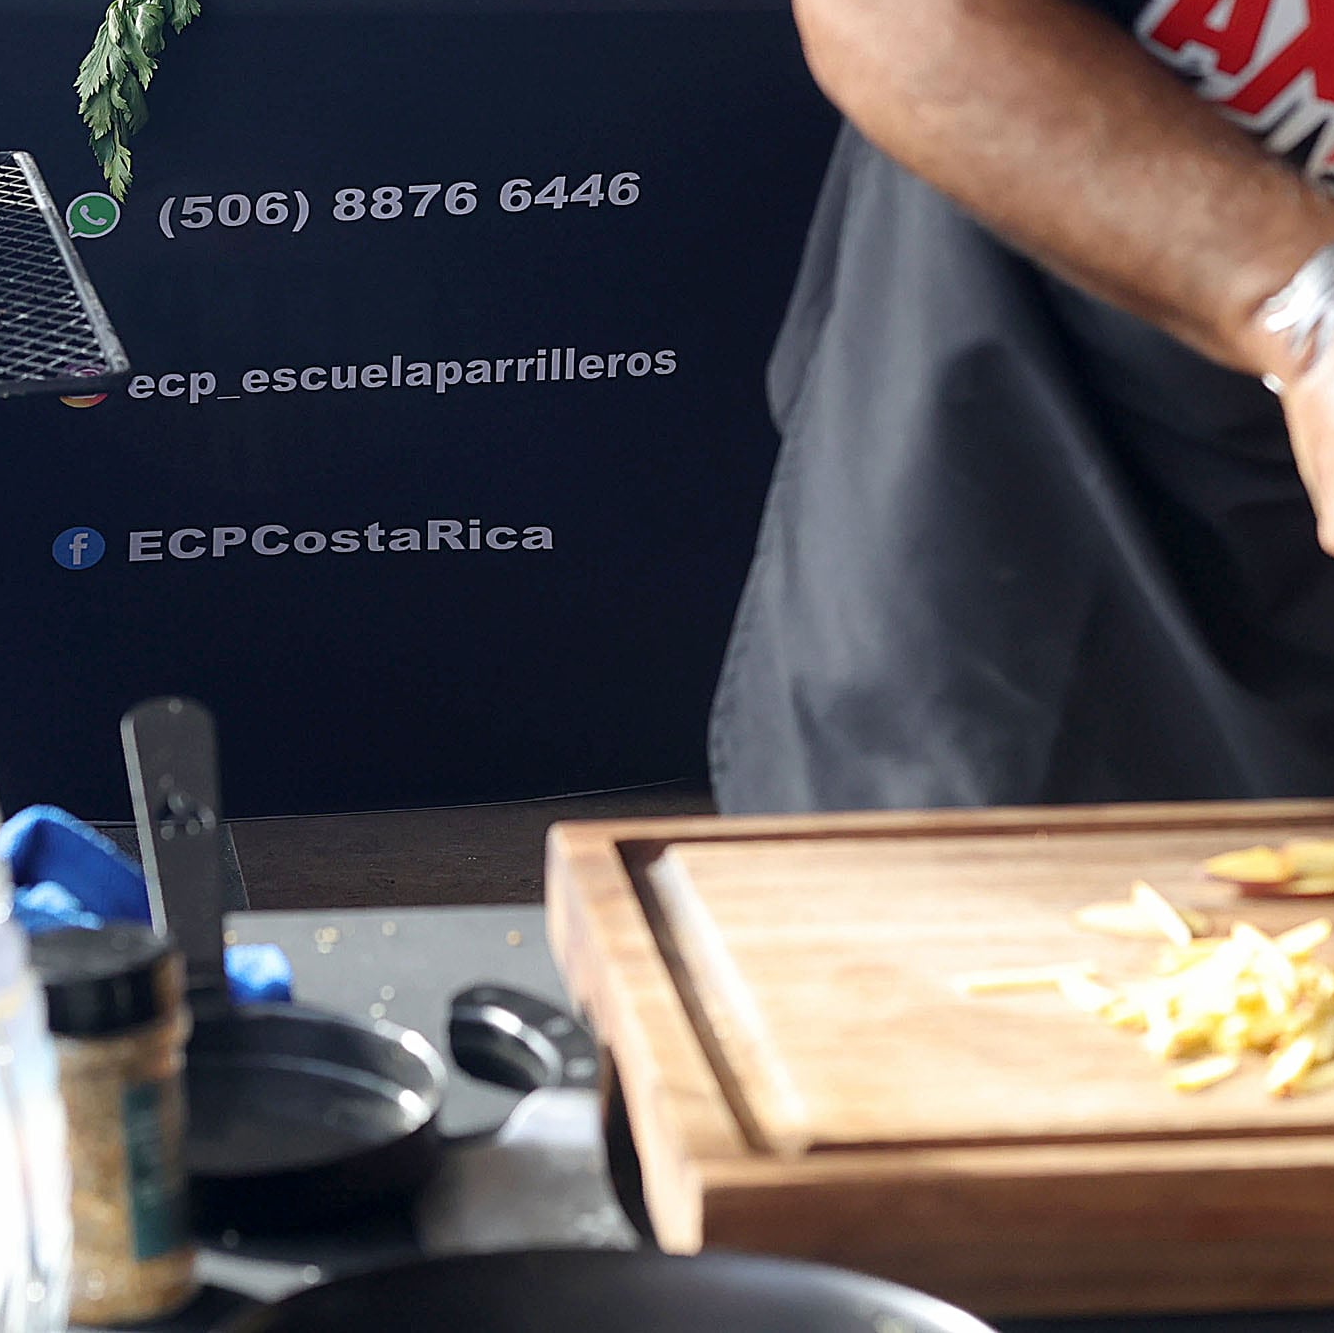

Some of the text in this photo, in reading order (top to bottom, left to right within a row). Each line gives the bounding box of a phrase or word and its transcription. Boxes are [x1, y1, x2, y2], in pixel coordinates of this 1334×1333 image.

[158, 171, 641, 239] (506) 8876 6446
[127, 347, 678, 404] ecp_escuelaparrilleros
[128, 518, 555, 562] ECPCostaRica
